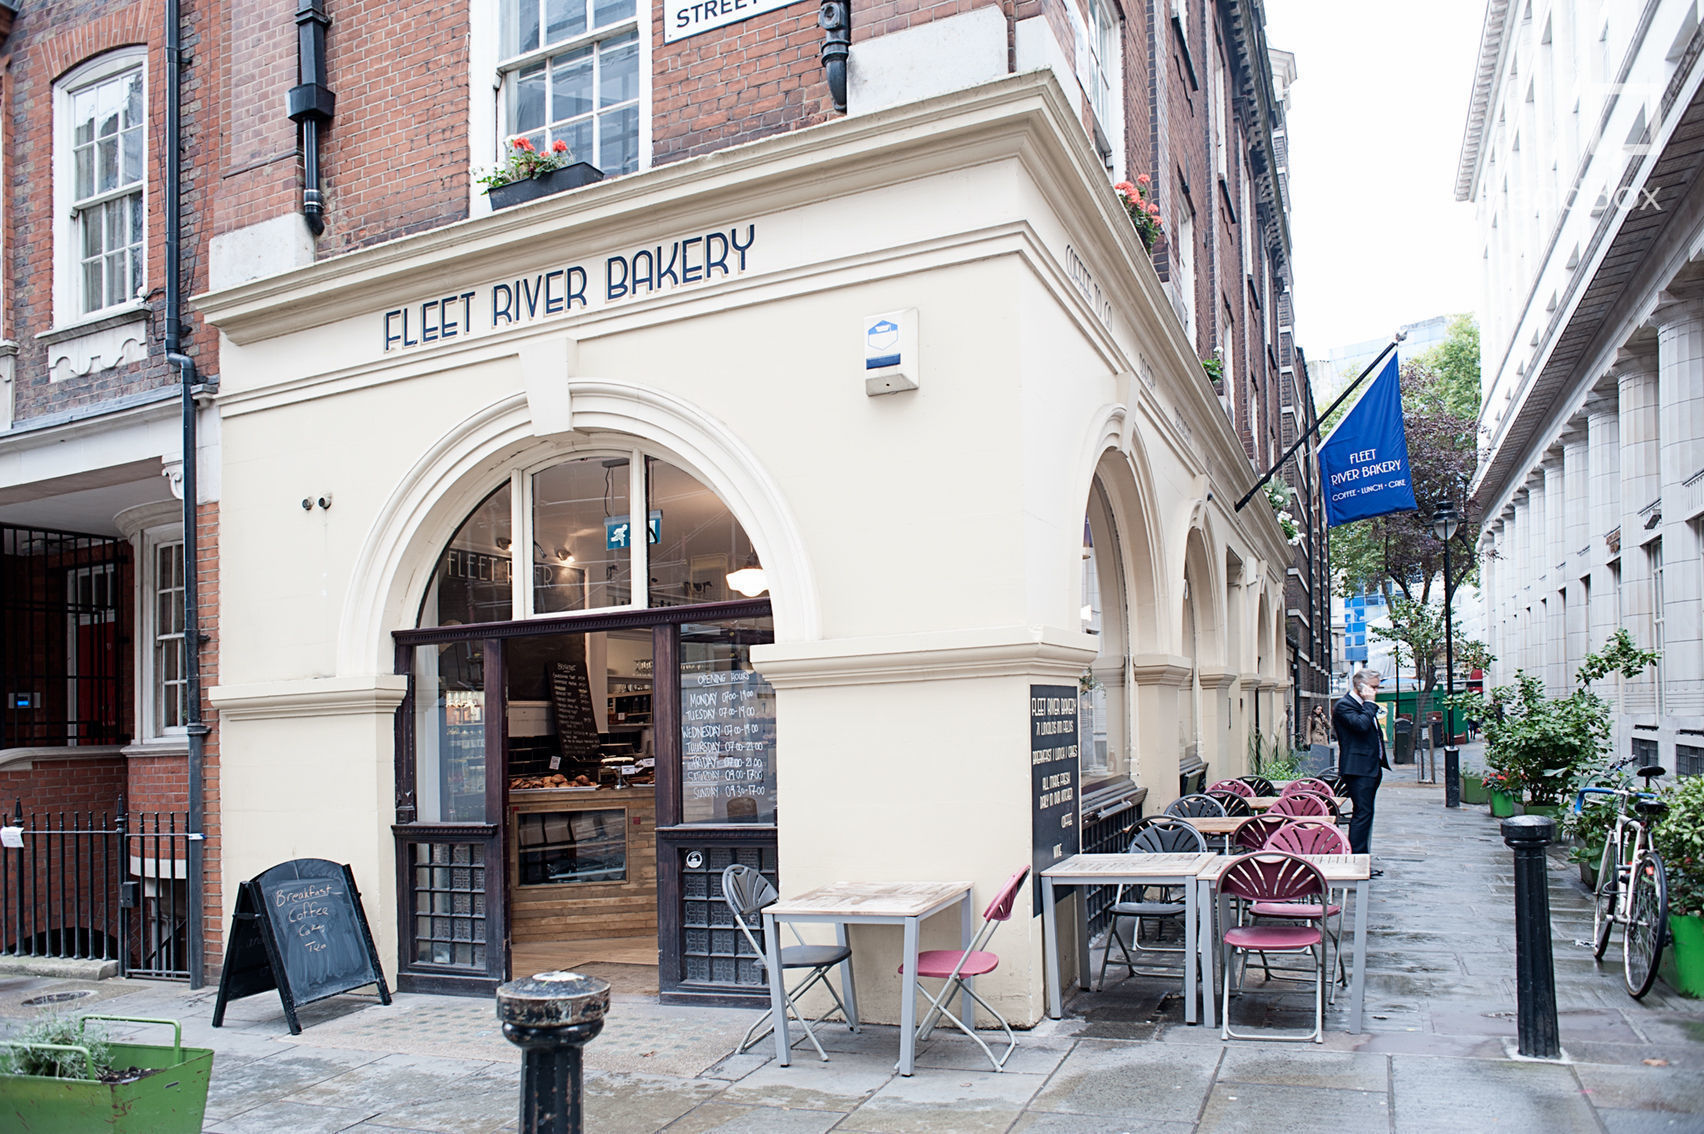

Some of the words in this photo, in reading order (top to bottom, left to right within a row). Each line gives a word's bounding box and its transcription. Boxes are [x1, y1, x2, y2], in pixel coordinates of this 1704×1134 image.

[677, 0, 757, 28] STREE
[384, 291, 476, 352] FLEET
[490, 265, 588, 330] RIVER
[605, 223, 755, 303] BAKERY
[1350, 448, 1376, 465] FLEET
[1331, 468, 1360, 486] RIVER
[1361, 459, 1401, 478] BAKERY
[1332, 488, 1357, 502] COFFEE
[1361, 483, 1384, 494] LUNCH
[1388, 479, 1406, 489] CAKE
[447, 550, 498, 582] FLEET
[506, 560, 553, 589] RER
[697, 672, 726, 685] OPENING
[730, 671, 750, 682] HOURS
[689, 691, 718, 708] MONDAY
[1032, 697, 1046, 717] FLEET
[685, 707, 716, 721] TUESDAY
[681, 724, 721, 739] WEDNESDAY
[685, 740, 721, 754] THURSDAY
[690, 755, 718, 769] FRIDAY
[693, 786, 719, 800] SUNDAY
[276, 884, 333, 908] Breakfast
[288, 901, 329, 923] Coffee
[305, 940, 327, 953] Tea
